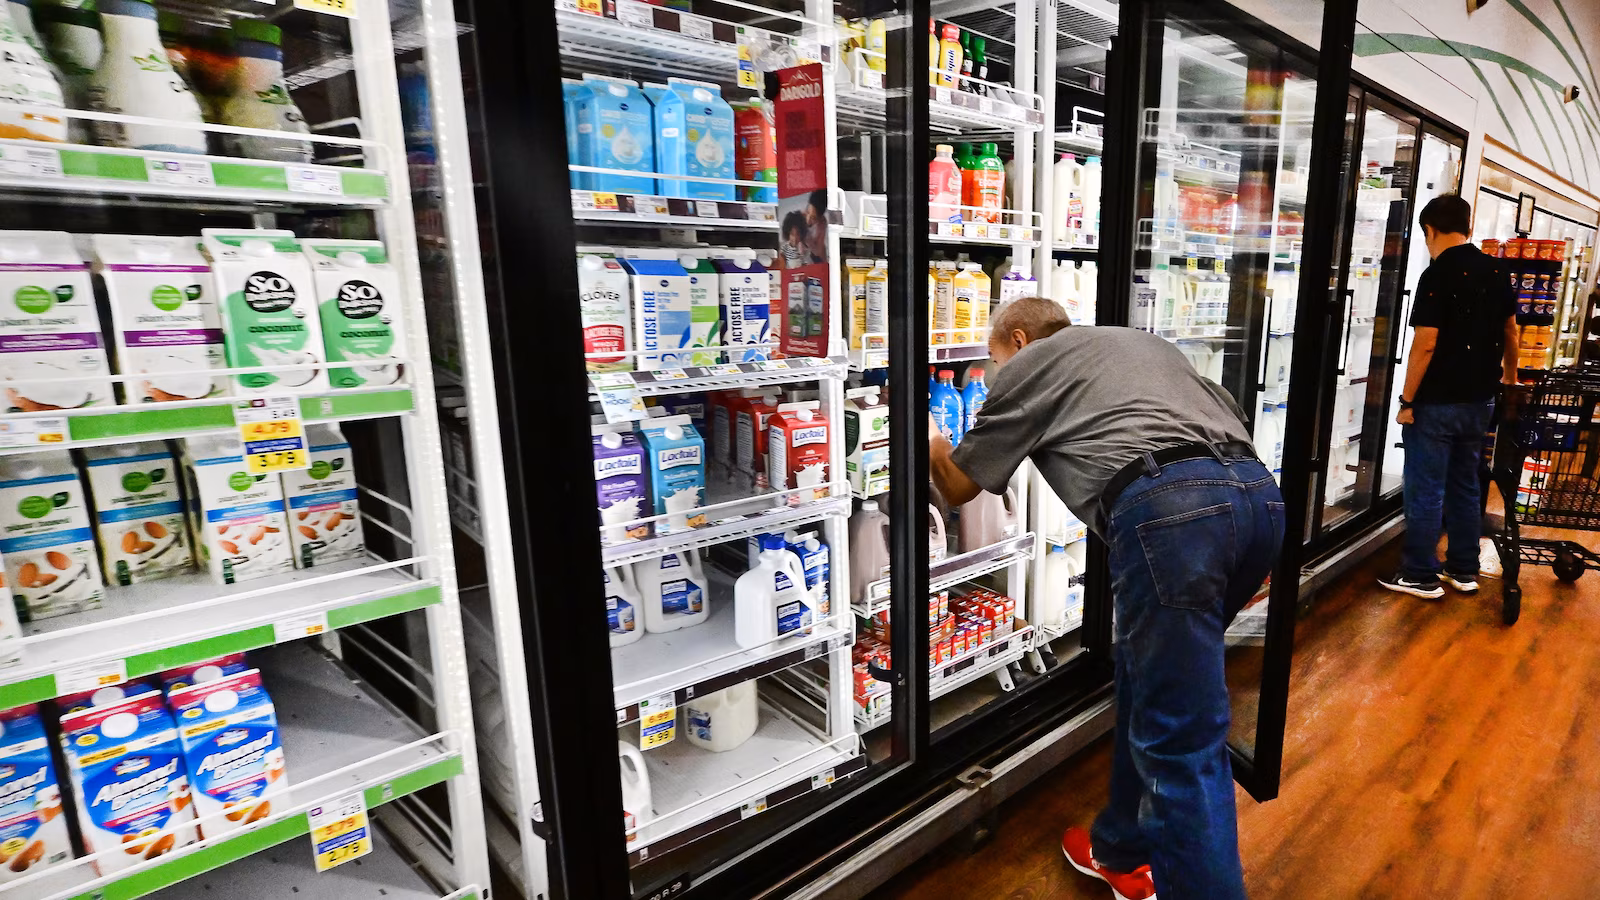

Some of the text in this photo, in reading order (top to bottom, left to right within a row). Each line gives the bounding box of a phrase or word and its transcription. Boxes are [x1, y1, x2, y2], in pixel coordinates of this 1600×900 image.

[944, 49, 956, 83] Nsquik
[780, 82, 822, 102] DARIGOLD
[248, 275, 290, 293] SO
[341, 284, 379, 300] SO
[580, 290, 621, 303] CLOVER
[643, 290, 657, 314] FREE
[730, 287, 744, 345] ACTOSE FREE
[794, 427, 825, 441] Lactaid
[598, 457, 638, 472] Lactaid
[662, 447, 698, 463] Lactaid
[649, 730, 669, 744] 5.99
[196, 730, 275, 776] Almond
[91, 757, 178, 807] Almond
[328, 841, 360, 862] 2.79
